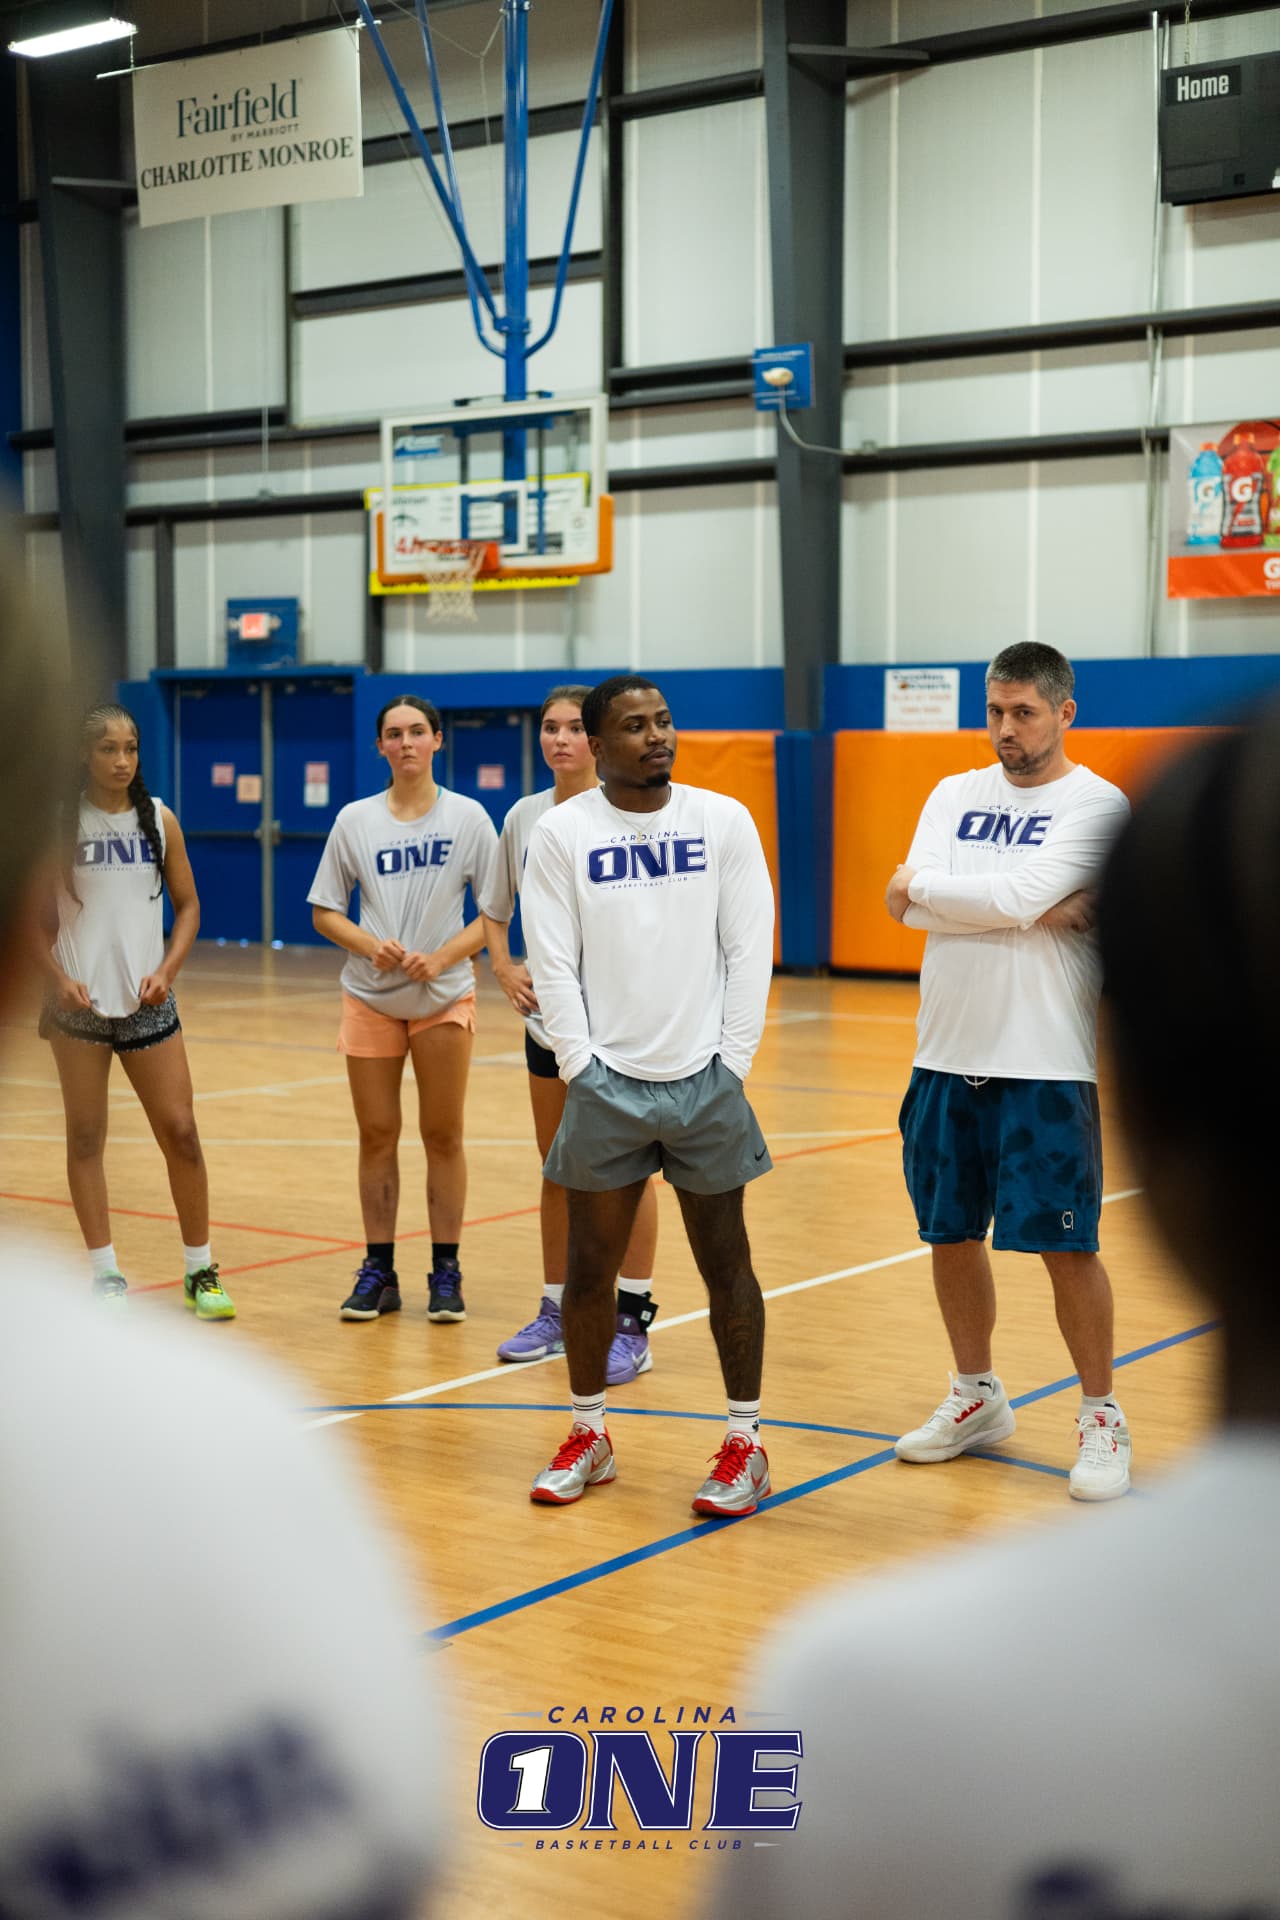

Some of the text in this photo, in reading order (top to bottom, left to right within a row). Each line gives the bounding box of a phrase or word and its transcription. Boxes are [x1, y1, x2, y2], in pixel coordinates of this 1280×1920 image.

[1176, 74, 1230, 102] Home
[176, 79, 299, 138] Fairfield
[230, 122, 300, 143] BY MARRIOTT
[140, 136, 354, 190] CHARLOTTE MONROE
[1231, 476, 1254, 502] G
[610, 829, 680, 844] CAROLINA
[956, 811, 1054, 847] ONE
[375, 838, 453, 876] ONE
[586, 836, 708, 885] ONE
